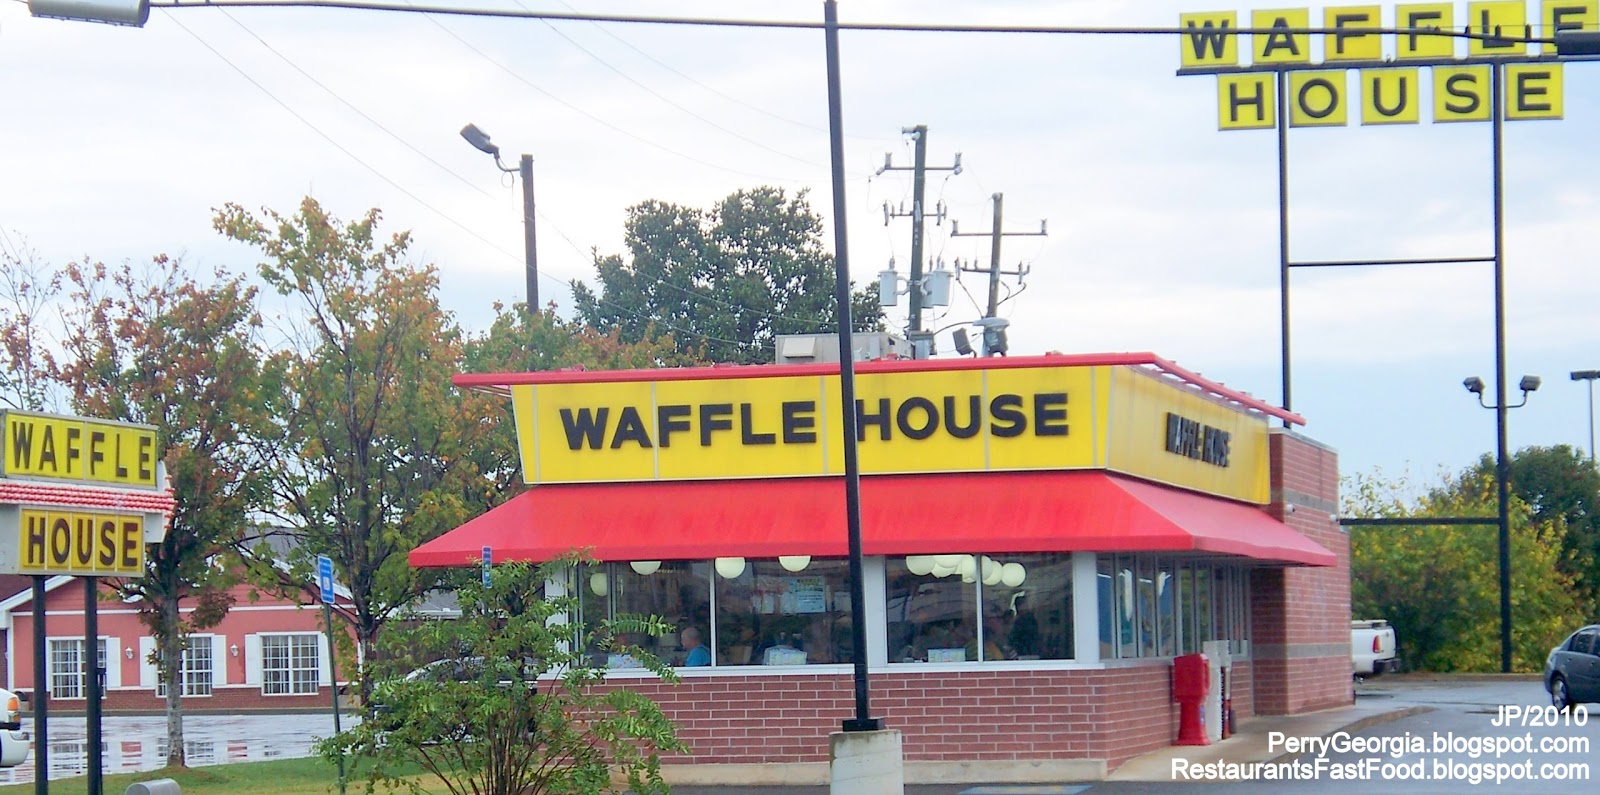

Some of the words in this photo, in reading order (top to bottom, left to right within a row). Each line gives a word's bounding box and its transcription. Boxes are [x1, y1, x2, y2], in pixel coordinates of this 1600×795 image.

[1229, 71, 1552, 122] HOUSE
[559, 401, 817, 450] WAFFLE
[855, 392, 1069, 441] HOUSE
[12, 421, 151, 480] WAFFLE
[28, 516, 139, 567] HOUSE
